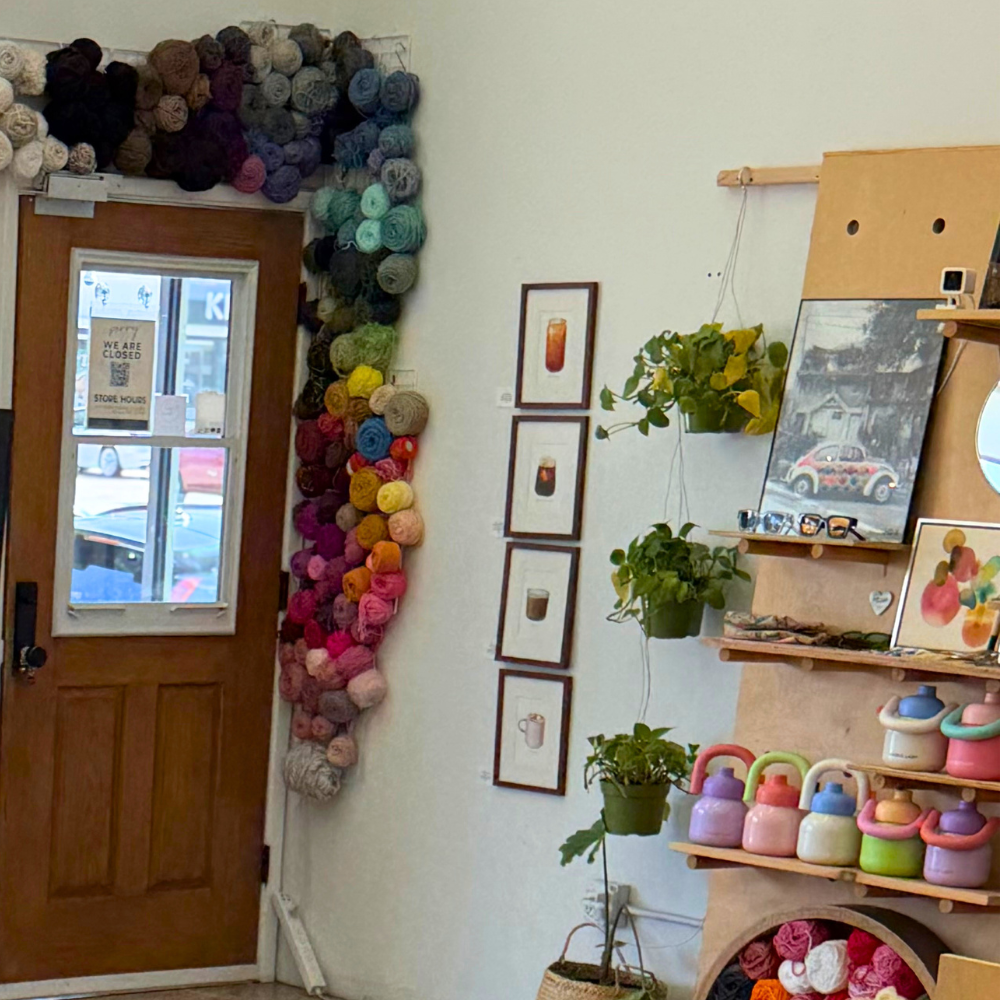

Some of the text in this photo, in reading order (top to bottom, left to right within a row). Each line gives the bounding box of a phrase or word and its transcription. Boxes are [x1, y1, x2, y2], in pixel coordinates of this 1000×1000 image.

[103, 341, 142, 351] WE ARE
[102, 350, 142, 360] CLOSED
[94, 394, 146, 404] STORE HOURS
